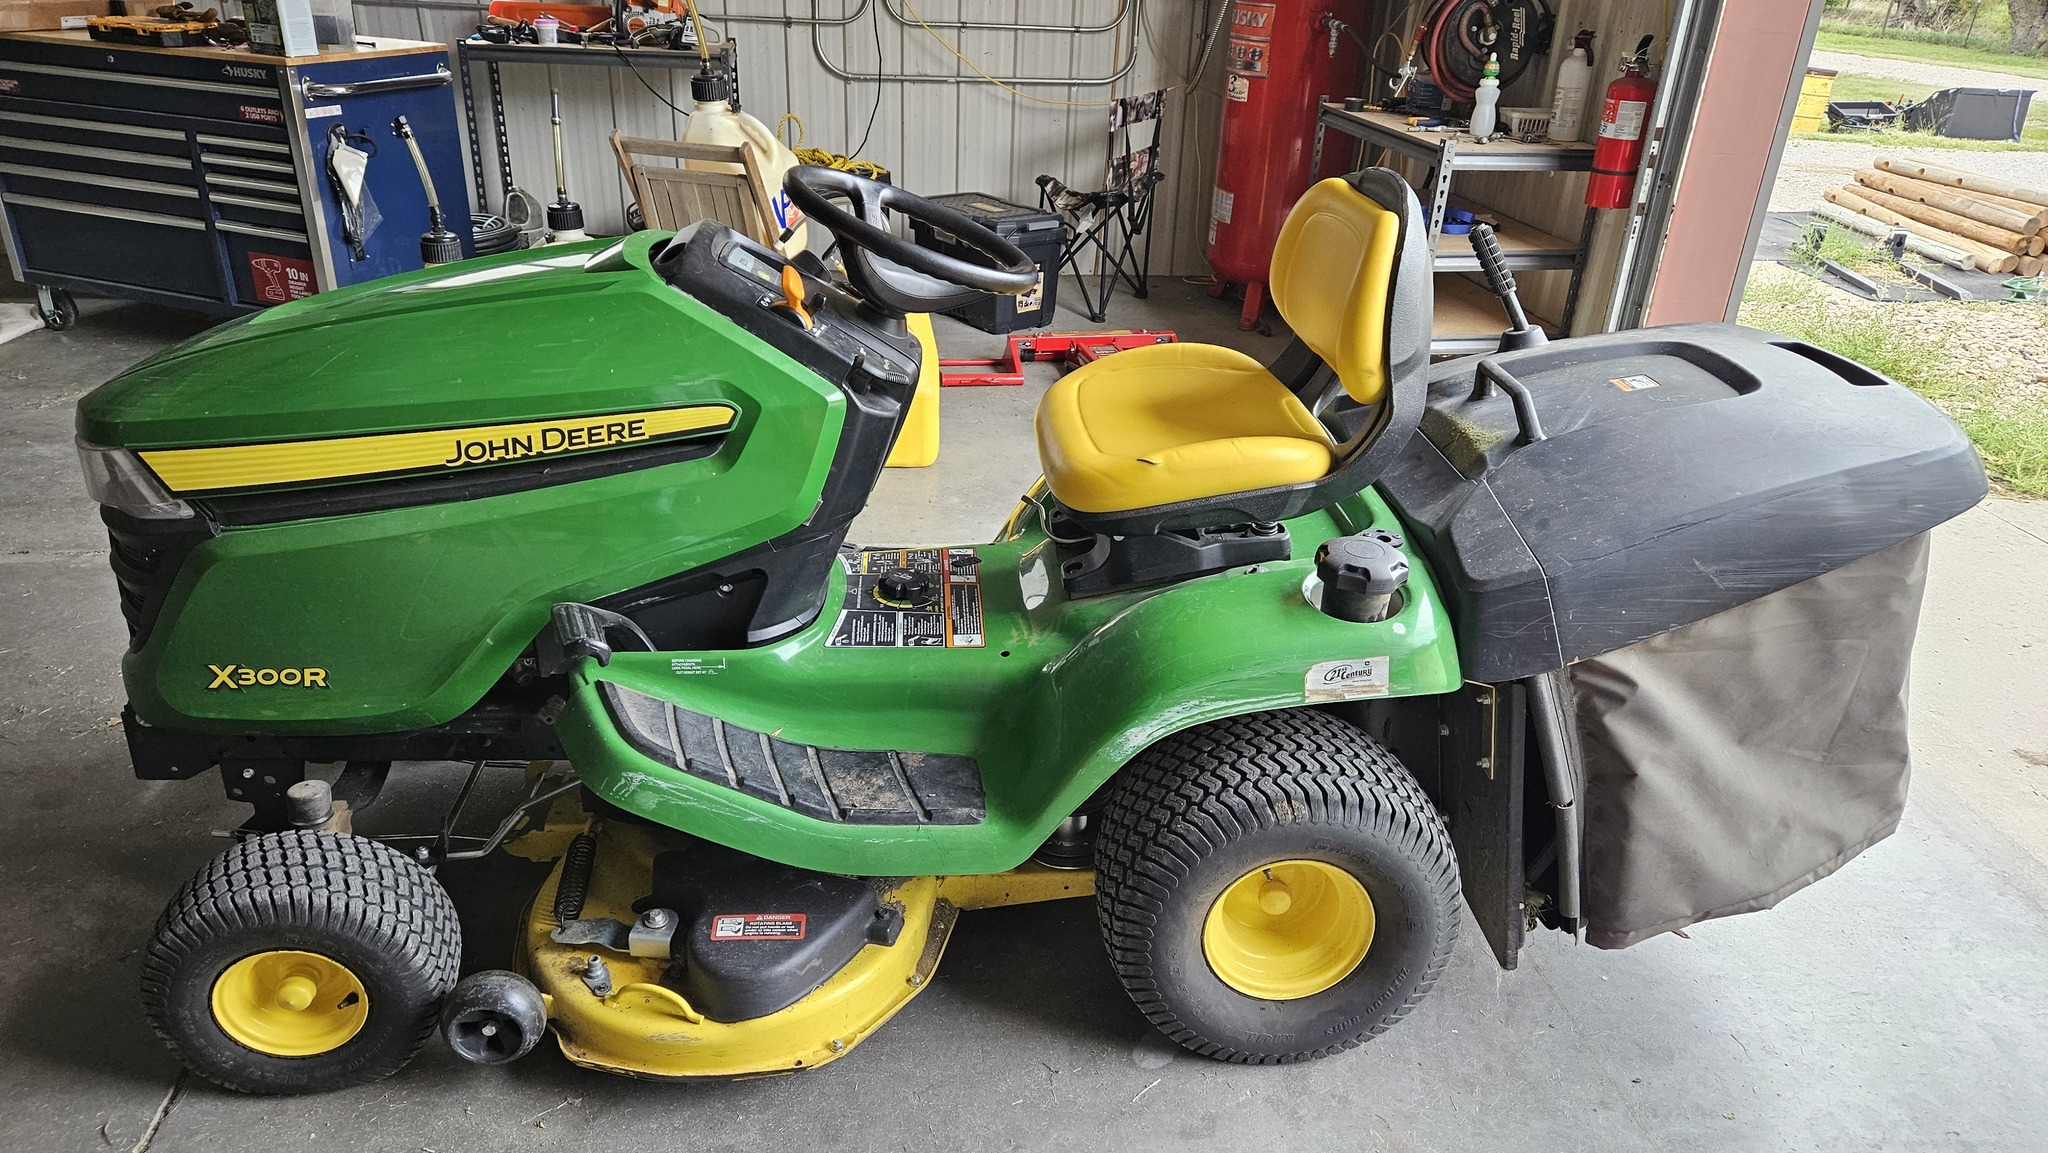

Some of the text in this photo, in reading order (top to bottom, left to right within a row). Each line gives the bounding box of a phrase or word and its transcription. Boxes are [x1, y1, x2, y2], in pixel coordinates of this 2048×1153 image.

[1232, 8, 1269, 28] USKY
[1510, 8, 1521, 60] Rapid-Reel
[233, 66, 268, 79] HUSKY
[1228, 75, 1238, 92] 3
[244, 106, 267, 114] OUTLETS
[285, 267, 309, 282] 10 IN
[445, 418, 646, 464] JOHN DEERE
[207, 664, 327, 689] X300R
[1340, 668, 1373, 680] Century
